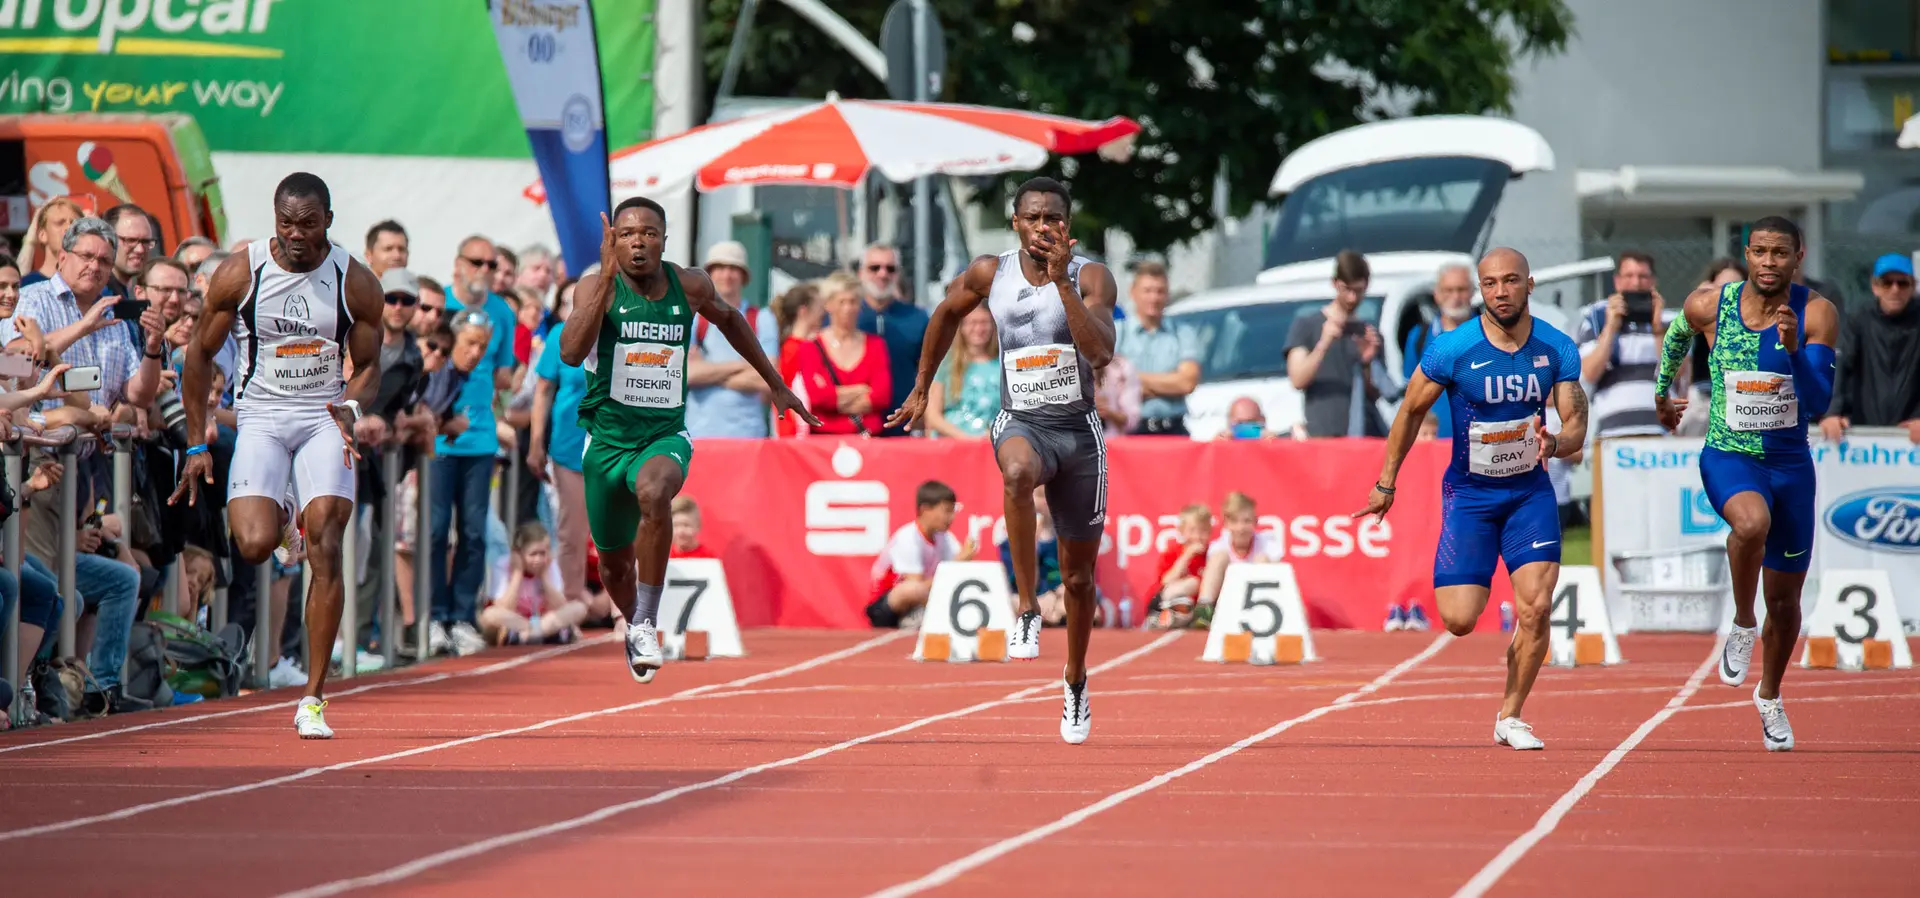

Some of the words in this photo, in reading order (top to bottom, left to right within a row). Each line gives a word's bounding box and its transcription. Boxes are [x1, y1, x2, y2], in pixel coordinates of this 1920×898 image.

[83, 80, 189, 112] your
[192, 80, 284, 117] way
[274, 320, 318, 337] Voléo
[621, 322, 684, 341] NIGERIA
[318, 354, 336, 364] 144
[275, 365, 329, 379] WILLIAMS
[665, 370, 681, 379] 145
[1056, 366, 1076, 376] 139
[279, 380, 325, 391] REHLINGEN
[625, 378, 671, 390] ITSEKIRI
[1012, 376, 1077, 393] OGUNLEWE
[1484, 373, 1542, 404] USA
[624, 394, 670, 404] REHLINGEN
[1023, 394, 1069, 406] REHLINGEN
[1736, 404, 1789, 416] RODRIGO
[1739, 420, 1785, 429] REHLINGEN
[1522, 437, 1537, 448] 13
[1491, 450, 1525, 464] GRAY
[1484, 463, 1531, 476] REHLINGEN
[667, 578, 709, 636] 7
[949, 578, 991, 638] 6
[1239, 581, 1284, 638] 5
[1550, 583, 1586, 640] 4
[1834, 584, 1879, 644] 3
